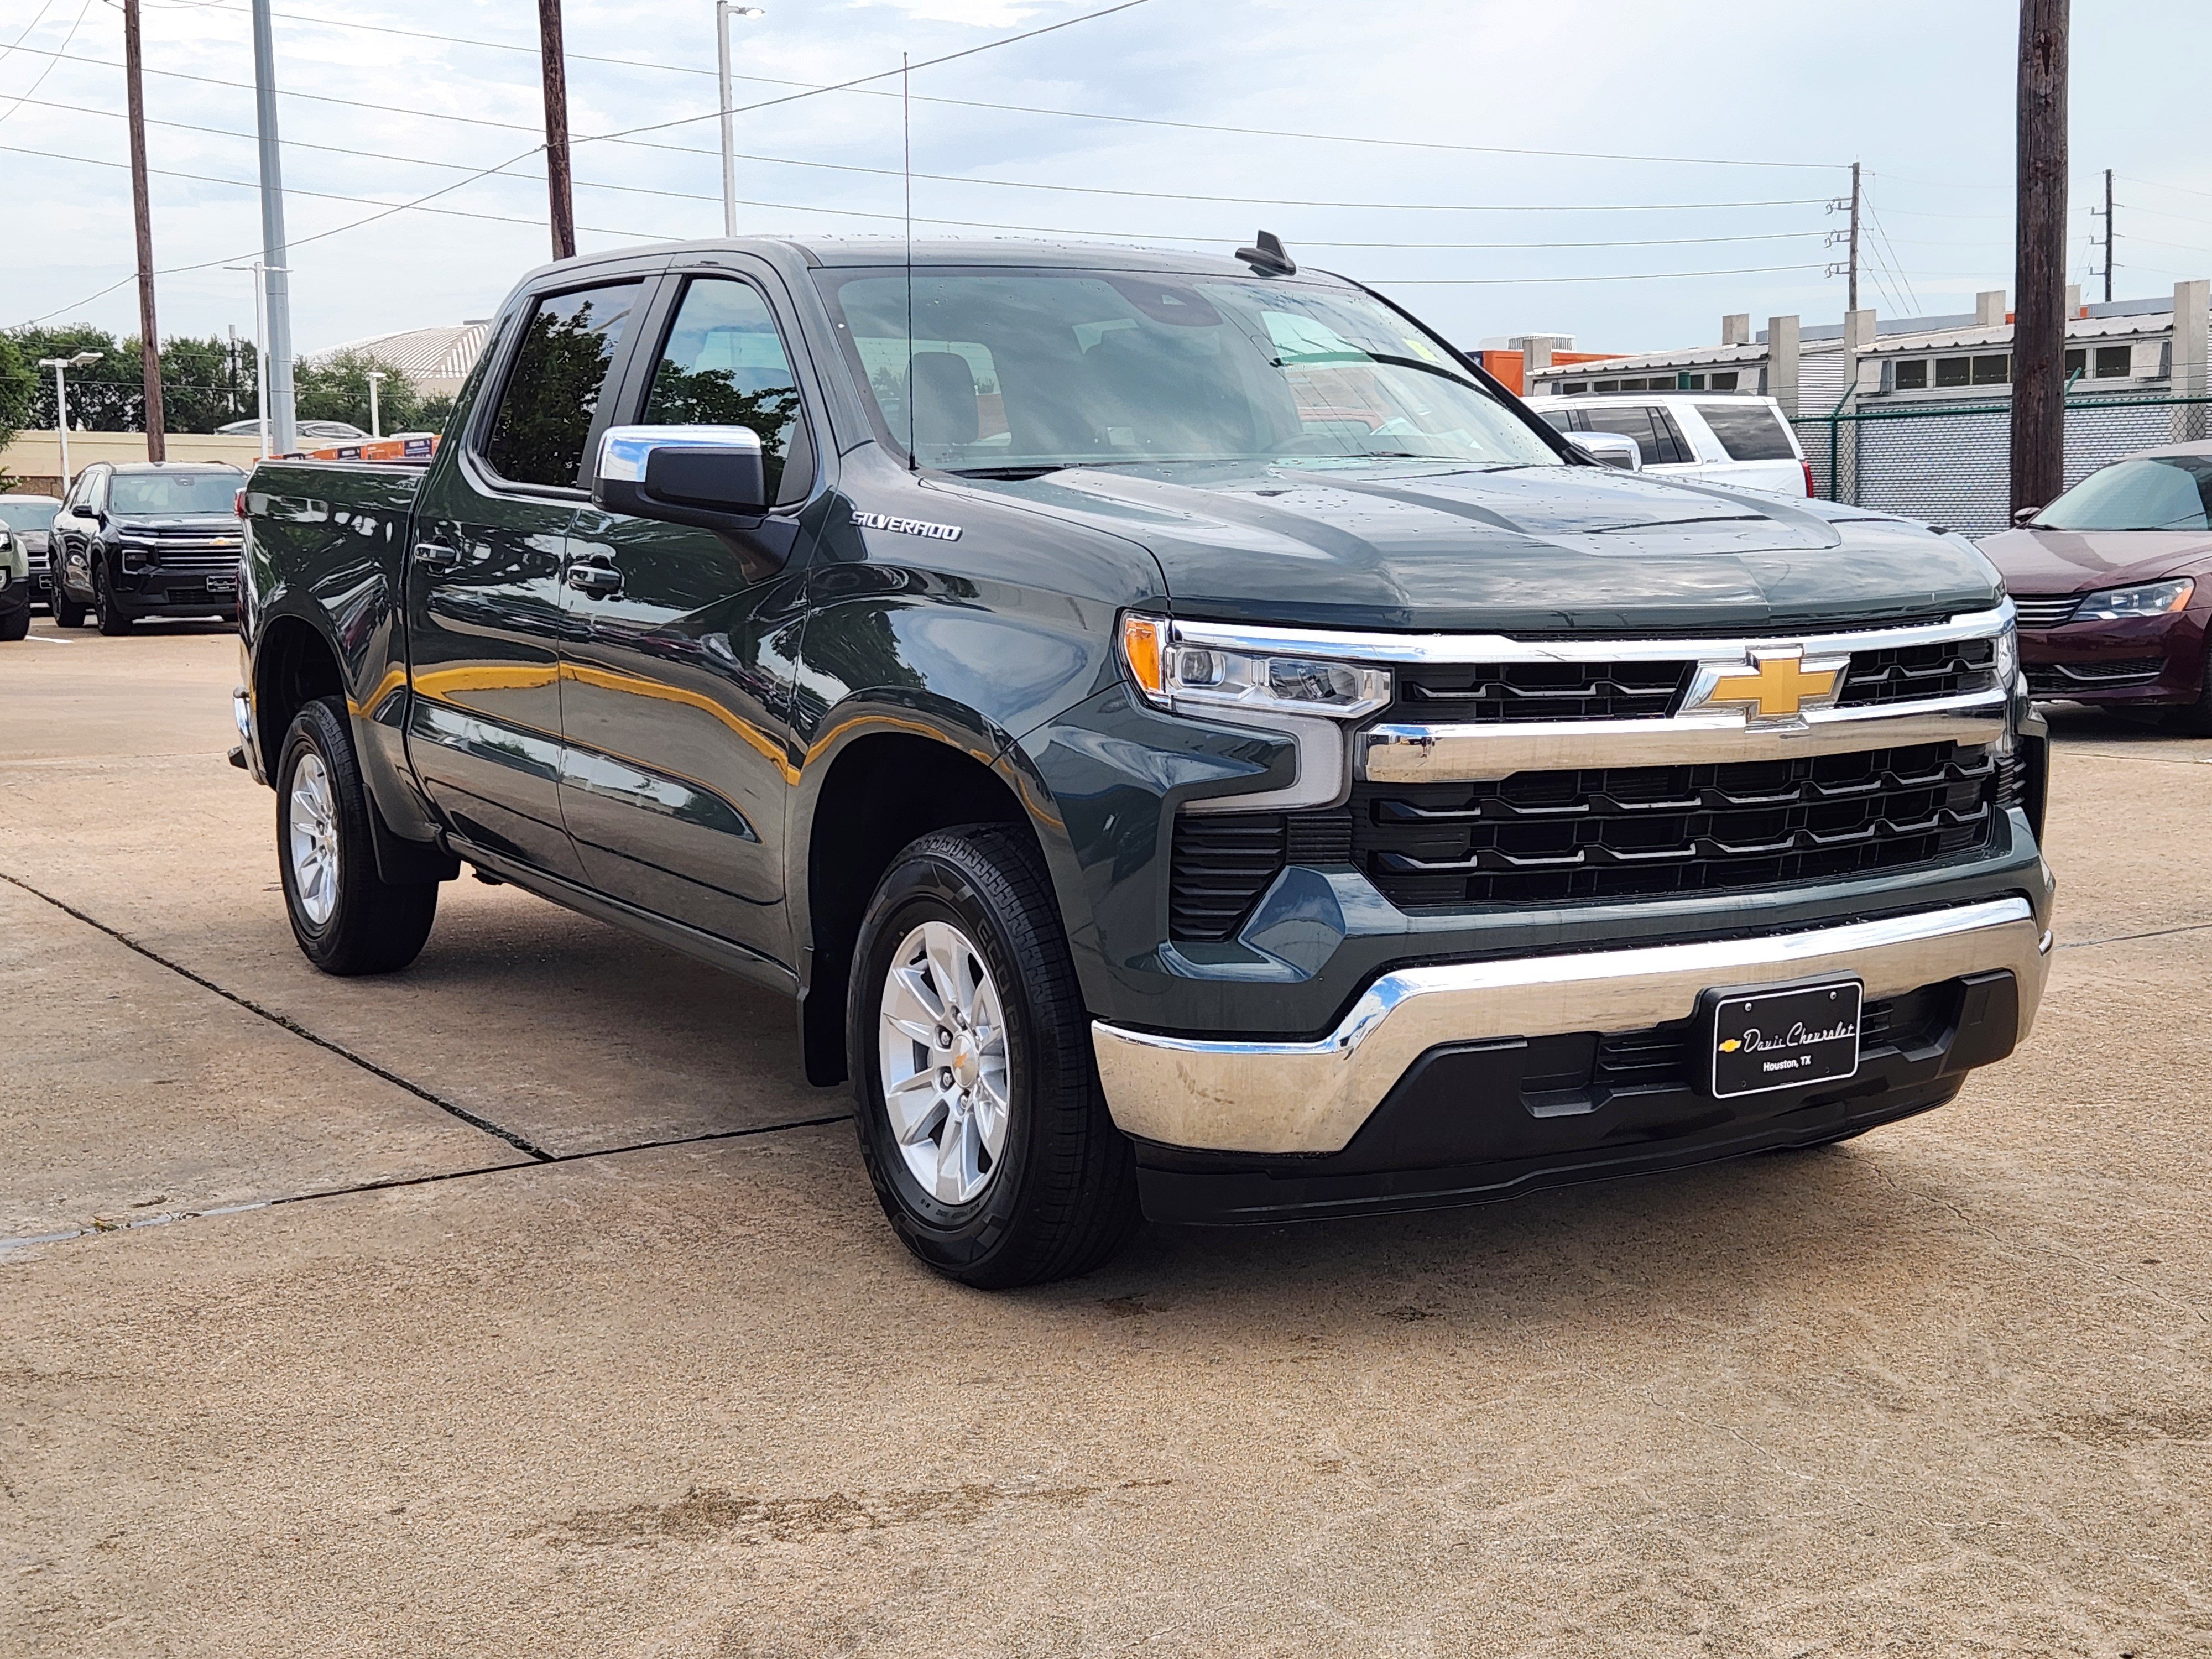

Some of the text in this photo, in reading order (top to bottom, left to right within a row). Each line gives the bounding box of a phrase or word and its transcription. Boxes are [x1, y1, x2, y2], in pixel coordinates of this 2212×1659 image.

[849, 511, 962, 541] SILVERADO
[1743, 1021, 1855, 1052] Davis Chevrolet
[1763, 1055, 1812, 1072] Houston, TX
